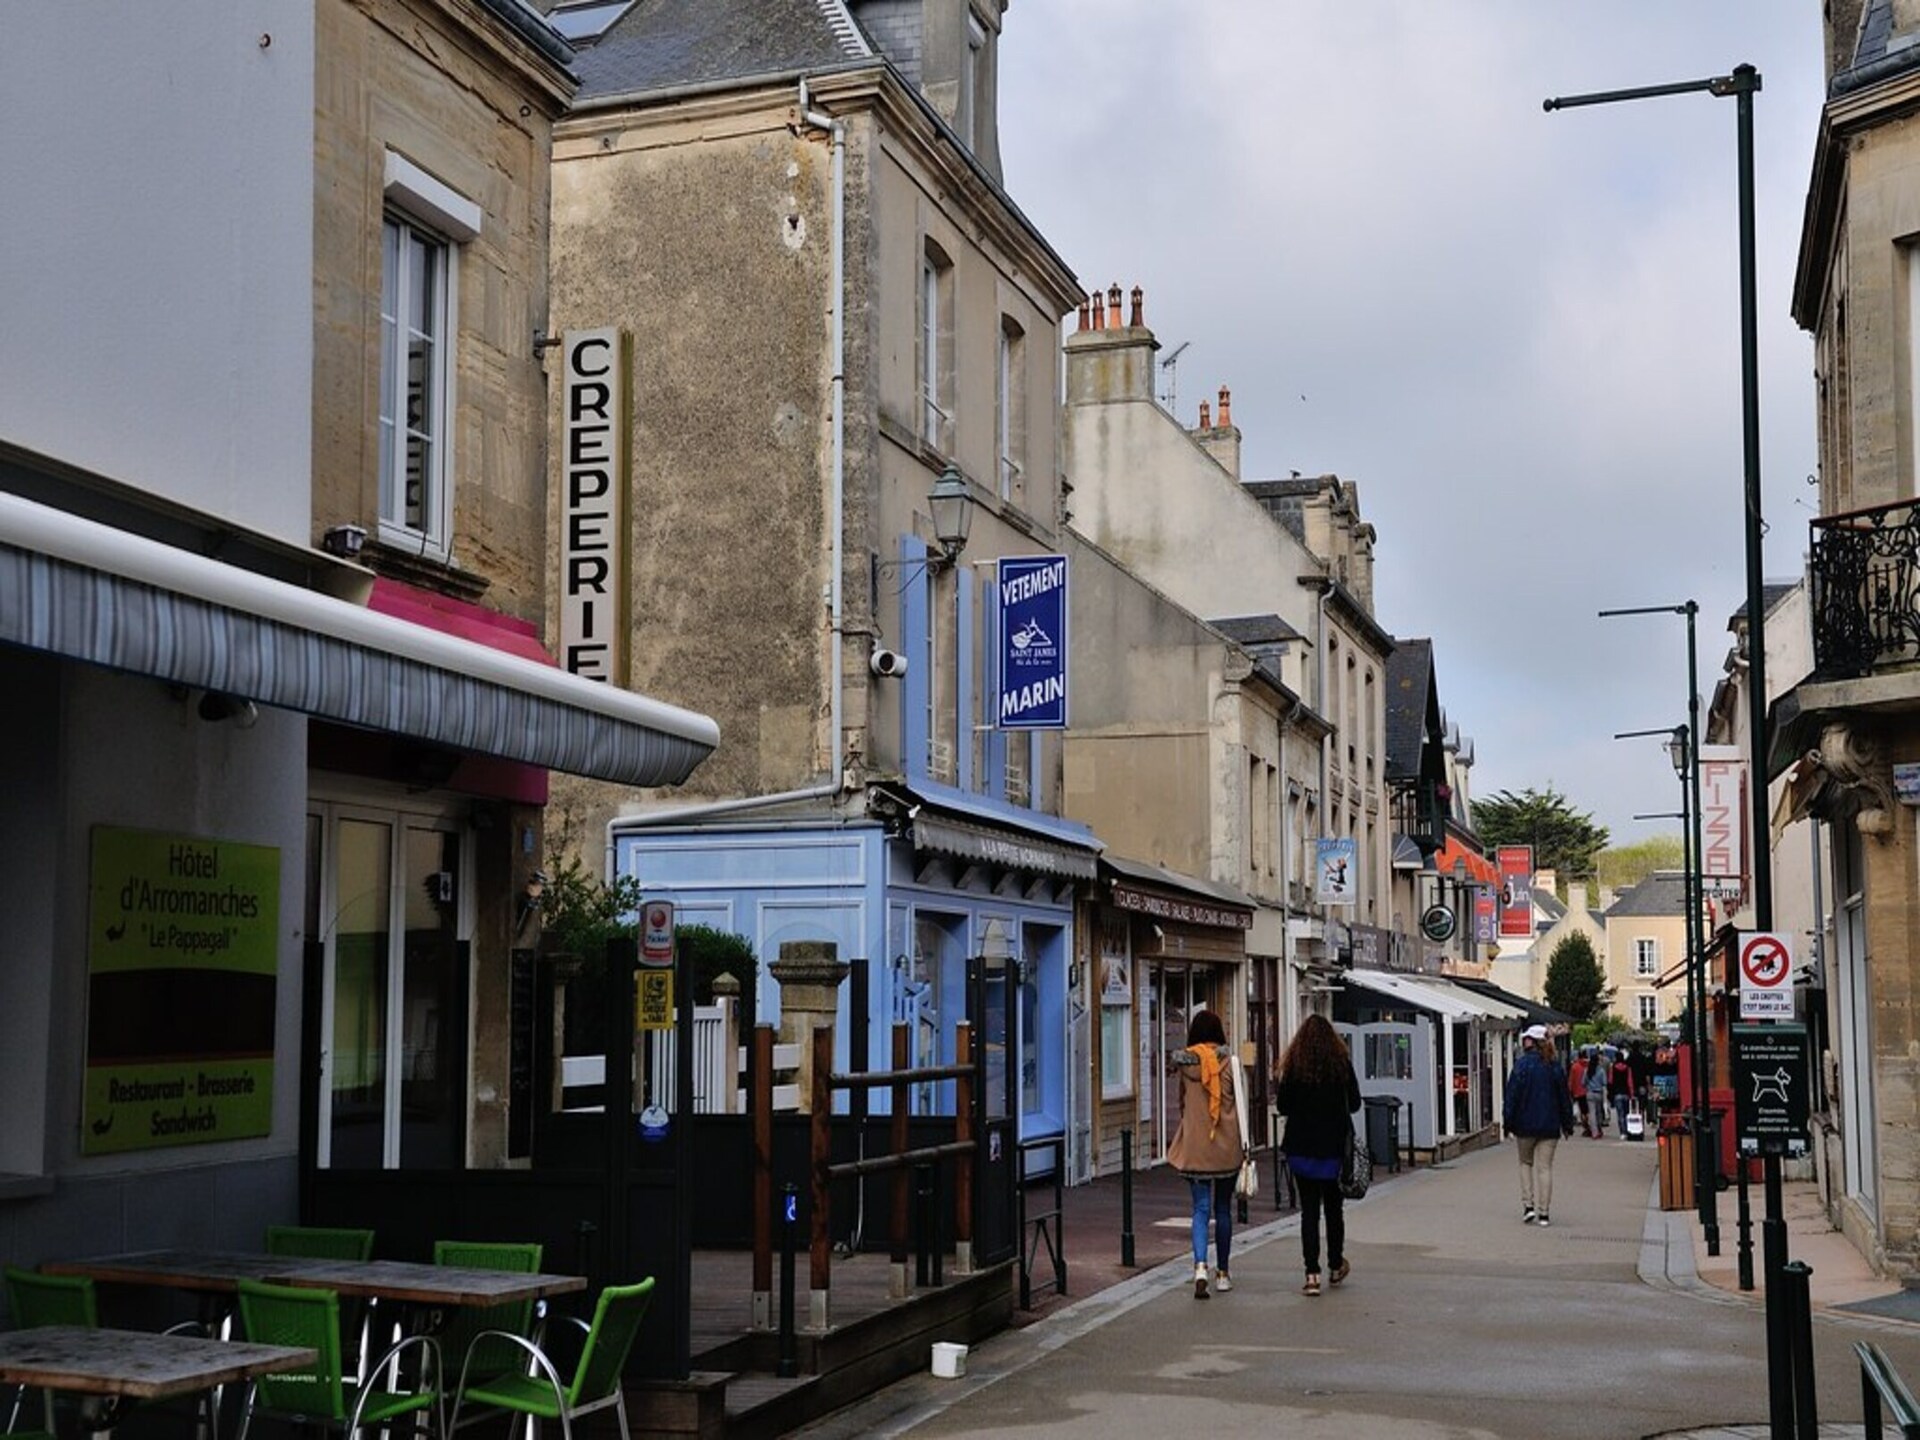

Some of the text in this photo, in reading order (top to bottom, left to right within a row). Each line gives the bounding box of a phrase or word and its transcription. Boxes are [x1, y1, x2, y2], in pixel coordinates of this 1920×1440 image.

[567, 338, 610, 682] CREPERIE
[1002, 561, 1064, 606] VETEMENT
[1001, 673, 1064, 718] MARIN
[1706, 762, 1730, 872] PIZZA
[169, 844, 218, 879] Hôtel
[121, 876, 258, 918] d'Arromanches
[109, 1073, 186, 1103] Restaurant
[197, 1069, 255, 1097] Brasserie
[151, 1106, 216, 1136] Sandwich
